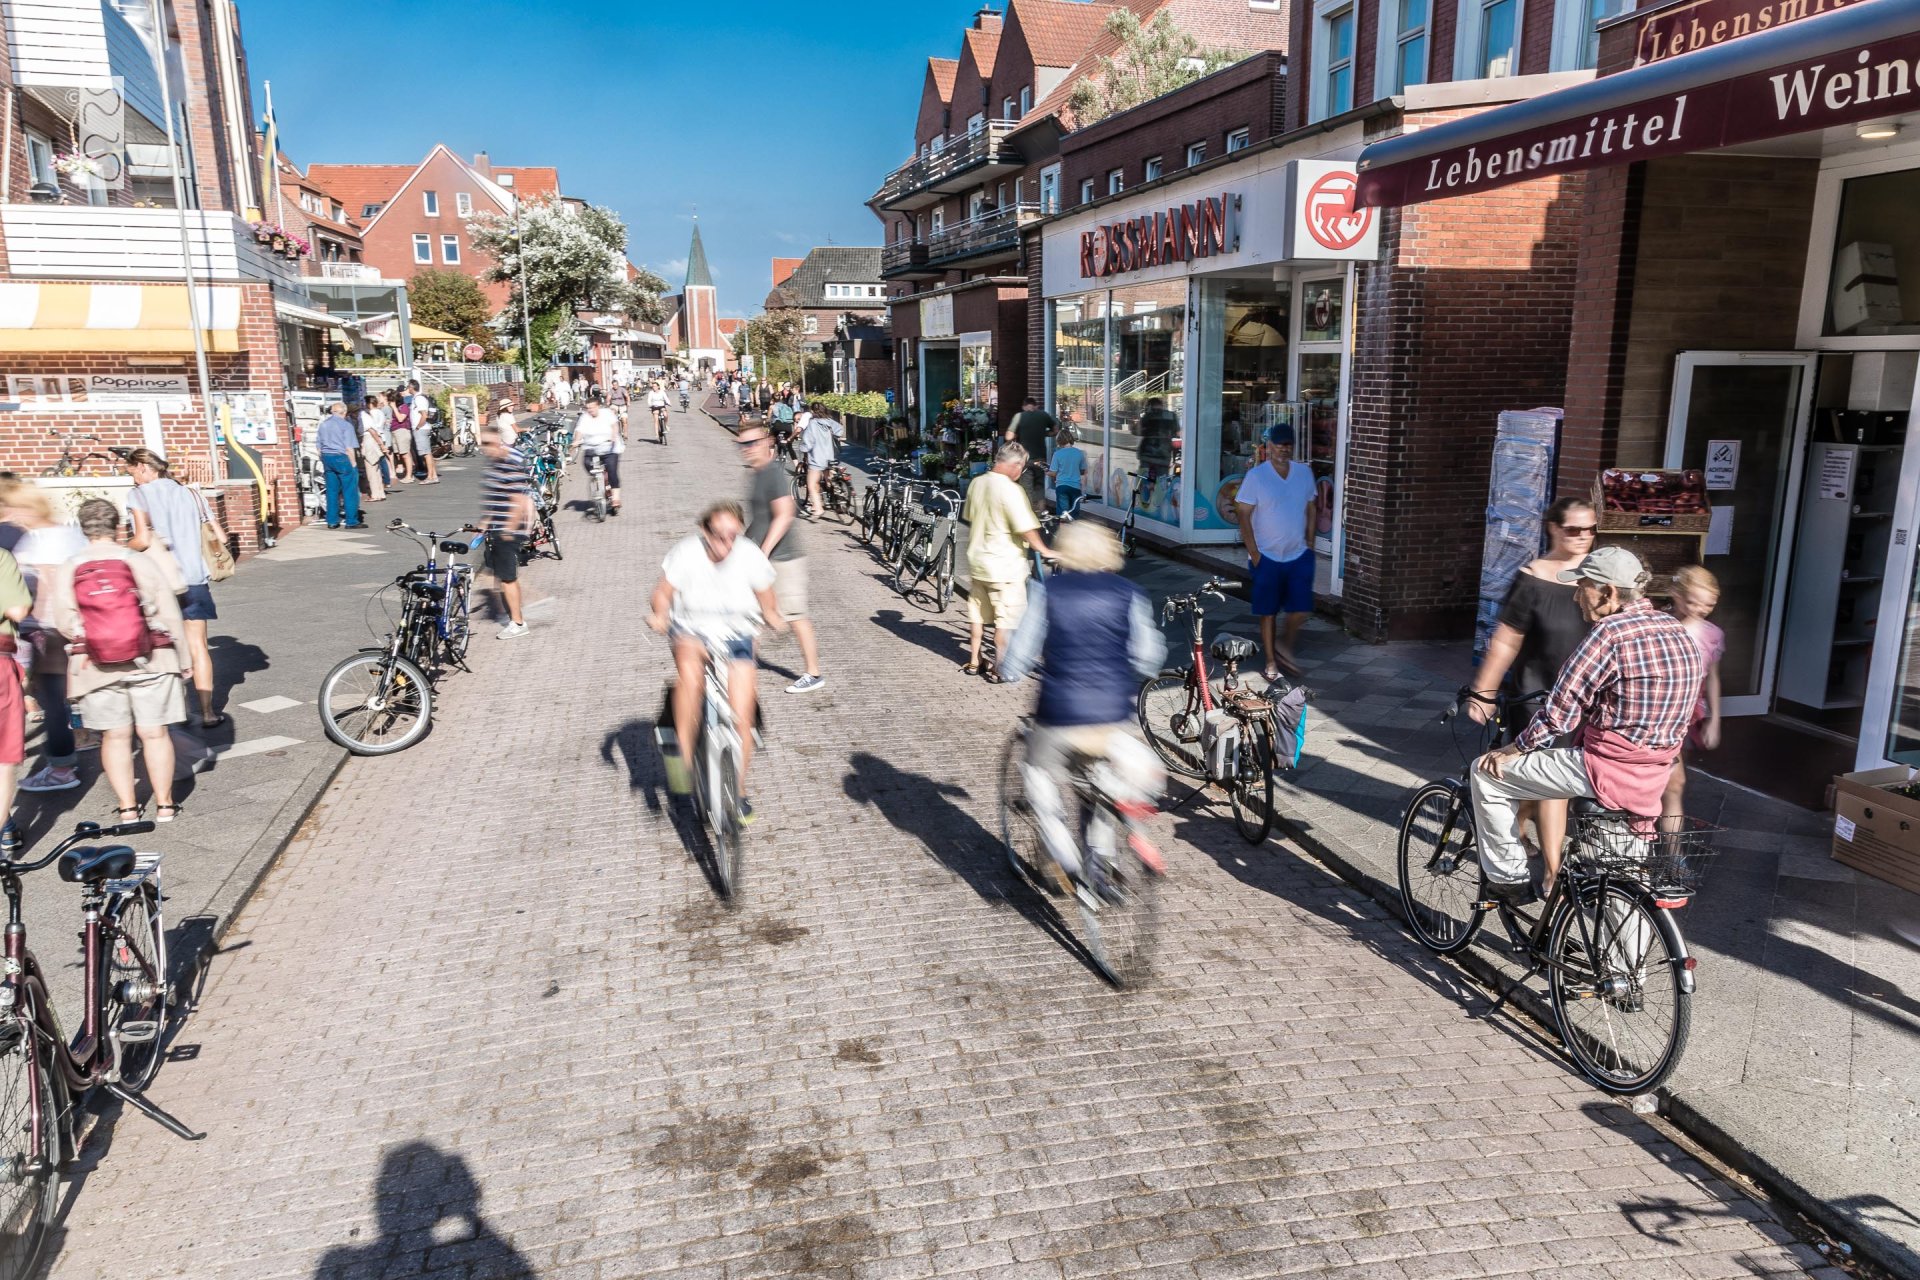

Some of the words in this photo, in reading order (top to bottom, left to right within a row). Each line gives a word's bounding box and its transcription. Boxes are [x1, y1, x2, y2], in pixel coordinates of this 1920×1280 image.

[1424, 94, 1688, 192] Lebensmittel
[1769, 49, 1920, 120] Wein
[1080, 192, 1236, 279] ROSSMANN
